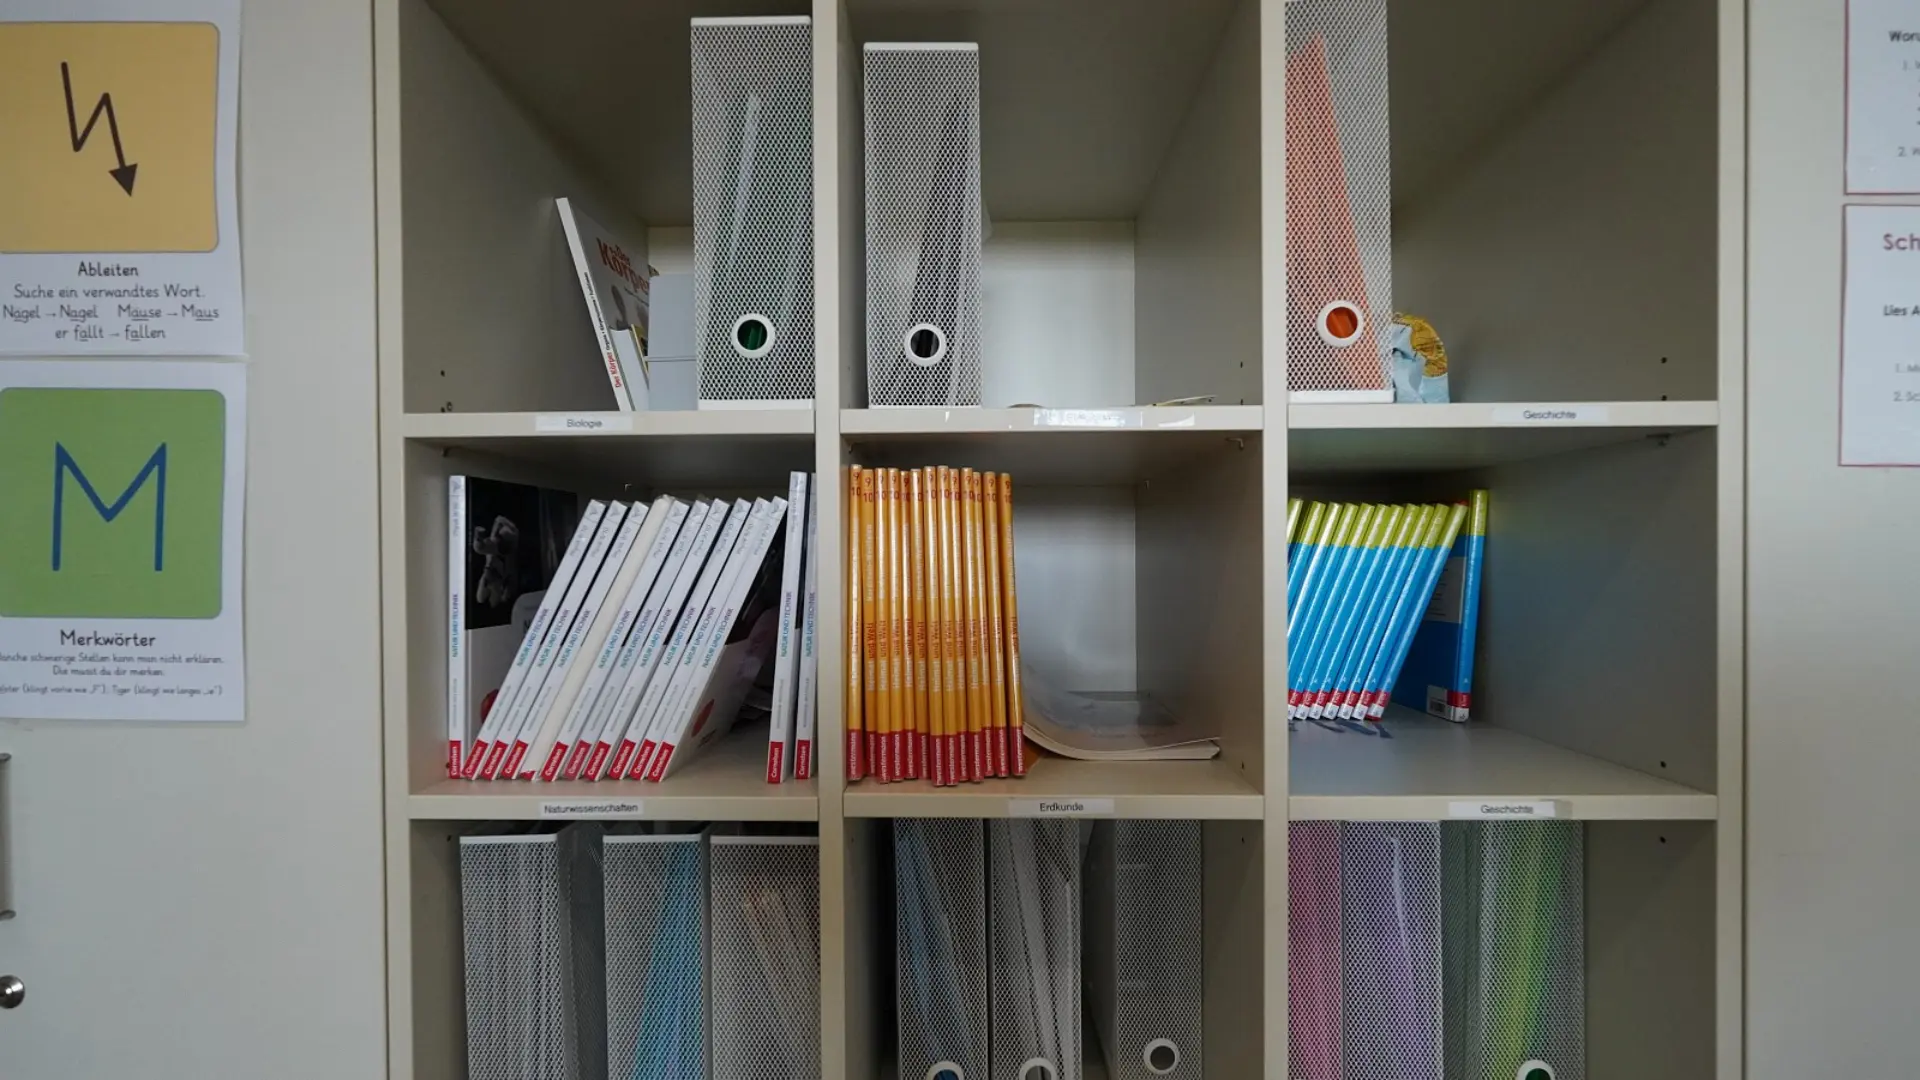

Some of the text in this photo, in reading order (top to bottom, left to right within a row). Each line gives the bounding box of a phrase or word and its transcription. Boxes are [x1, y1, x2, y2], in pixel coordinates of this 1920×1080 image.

[78, 260, 139, 277] Ableiten
[14, 283, 206, 299] Suche ein verwandtes Wort.
[181, 304, 219, 320] Maus
[1883, 305, 1907, 317] Lies
[55, 329, 69, 339] er
[125, 324, 166, 341] fallen
[566, 419, 603, 429] Biologie
[1523, 410, 1577, 420] Geschichte
[851, 486, 861, 497] 10
[863, 493, 873, 503] 10
[52, 441, 167, 571] M
[60, 629, 156, 647] Merkwörter
[527, 632, 537, 647] UND
[537, 608, 569, 667] NATUR UND TECHNIK
[640, 647, 654, 668] NATUR
[650, 633, 660, 648] UND
[657, 608, 672, 633] TECHNIK
[664, 607, 695, 666] NATUR UND TECHNIK
[684, 606, 715, 666] NATUR UND TECHNIK
[701, 607, 733, 668] NATUR UND TECHNIK
[916, 621, 924, 641] Welt
[568, 634, 578, 648] UND
[609, 634, 618, 649] UND
[630, 634, 640, 648] UND
[0, 652, 28, 661] anche
[466, 746, 482, 773] Cornelsen
[485, 746, 502, 774] Cornelsen
[505, 746, 522, 773] Cornelsen
[545, 748, 562, 776] Cornelsen
[568, 746, 585, 773] Cornelsen
[587, 747, 604, 775] Cornelsen
[613, 745, 630, 773] Cornelsen
[633, 745, 650, 773] Cornelsen
[652, 748, 668, 777] Cornelsen
[770, 747, 779, 777] Cornelsen
[798, 745, 806, 775] Cornelsen
[544, 804, 639, 814] Naturwissenschaften
[1039, 802, 1084, 812] Erdkunde
[1481, 804, 1534, 814] Geschichte
